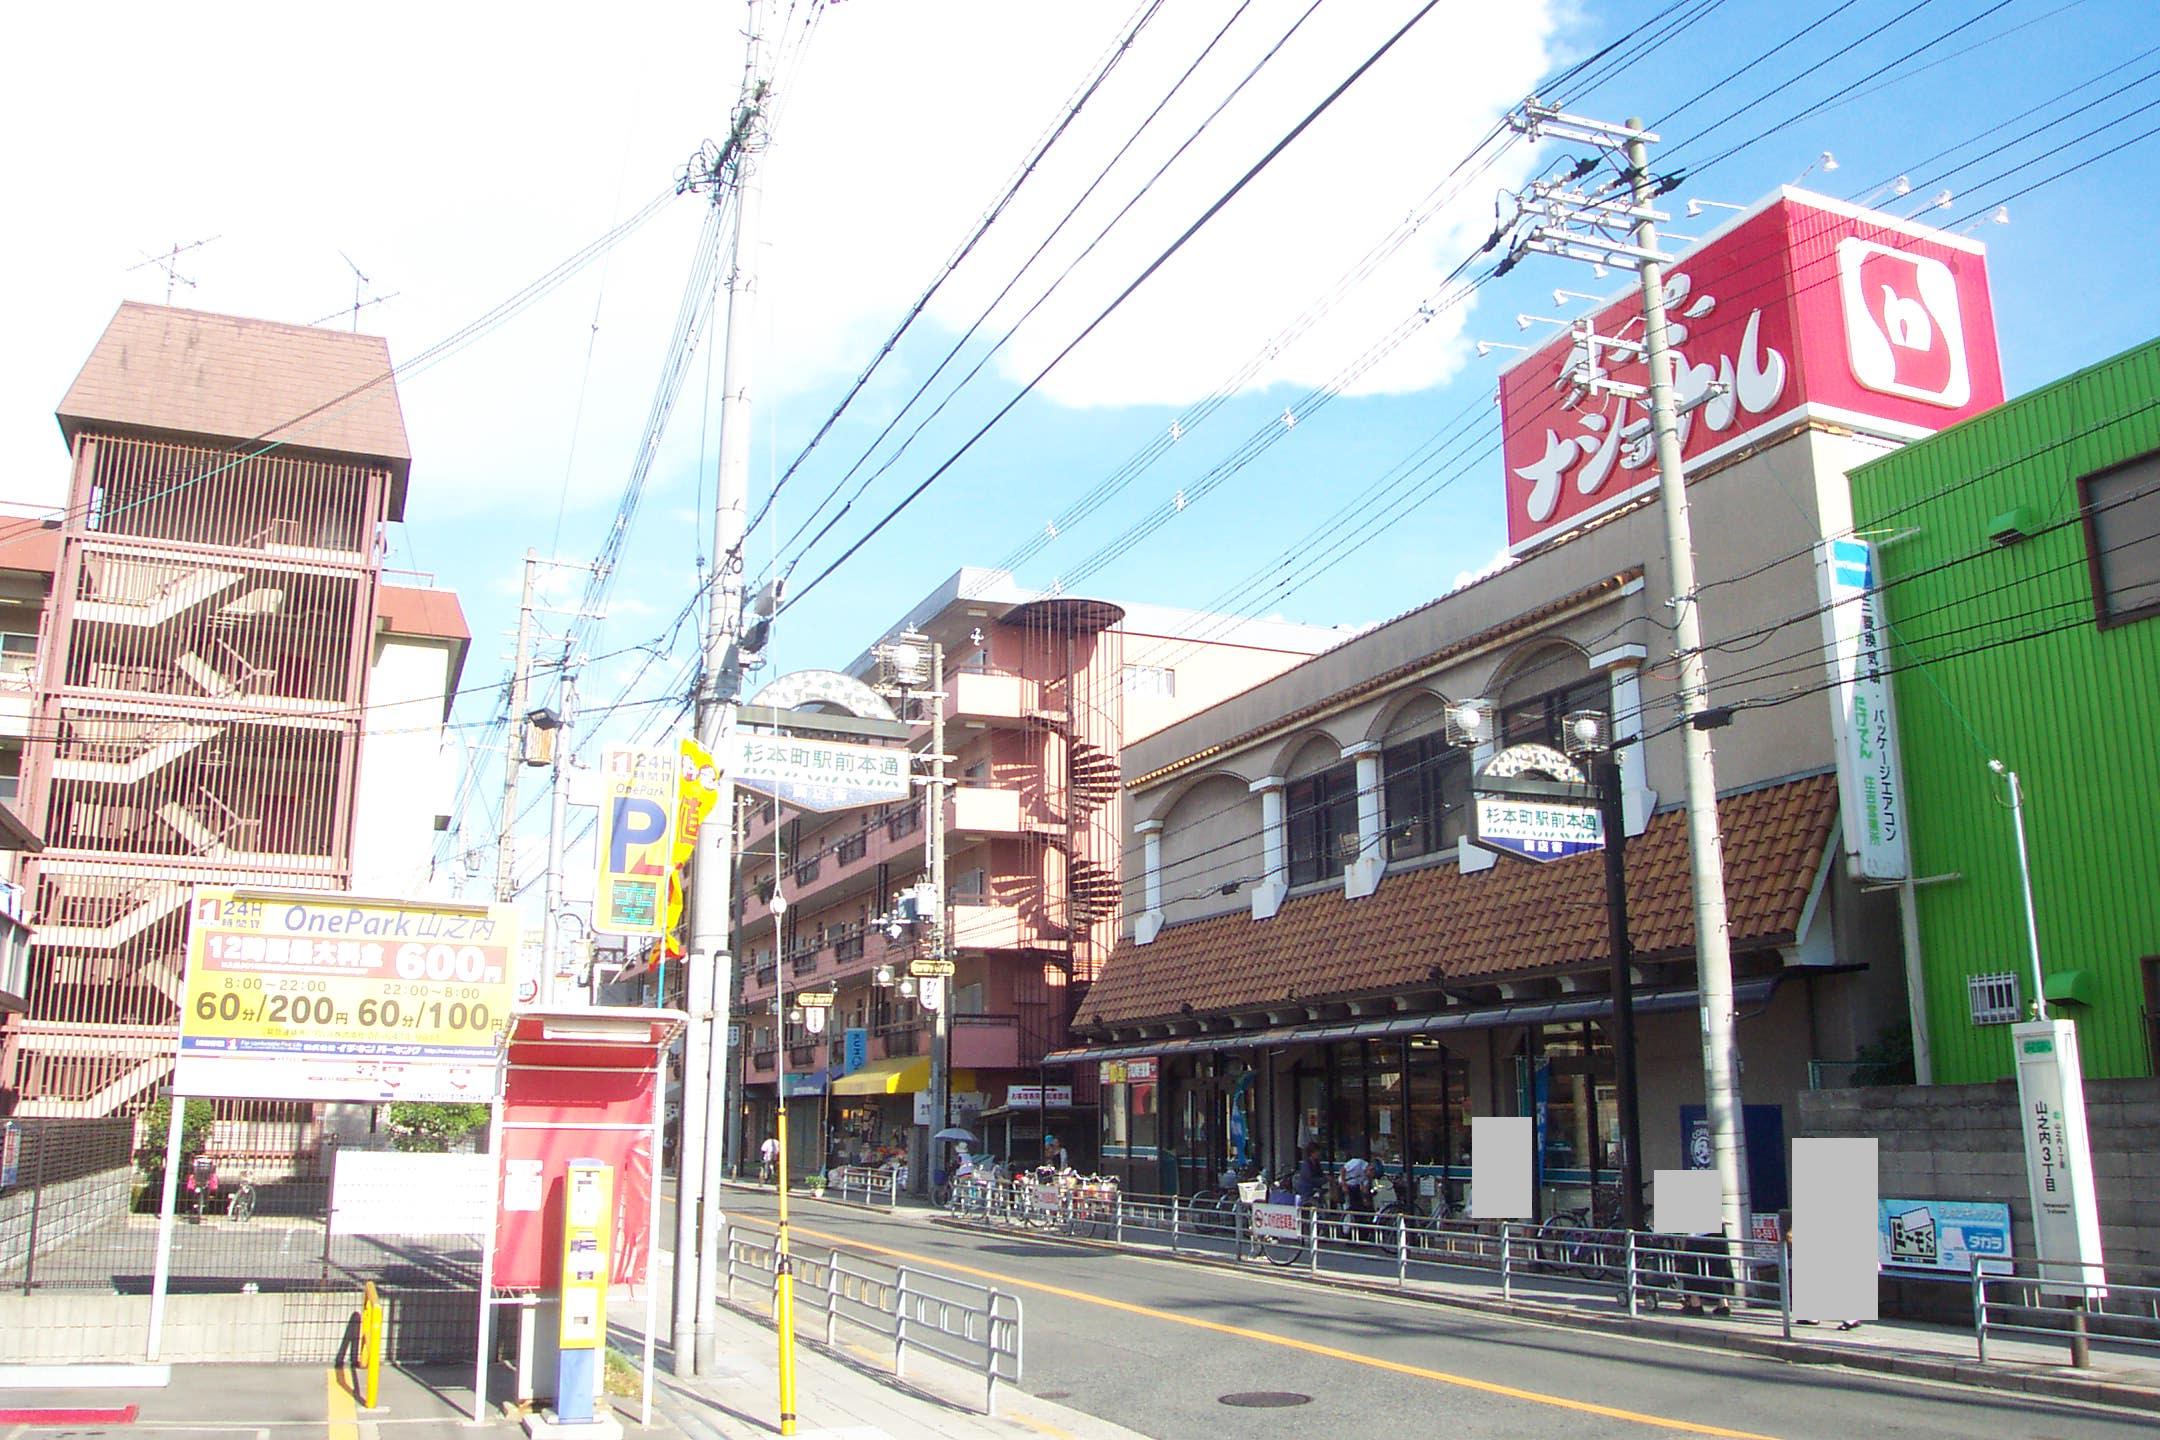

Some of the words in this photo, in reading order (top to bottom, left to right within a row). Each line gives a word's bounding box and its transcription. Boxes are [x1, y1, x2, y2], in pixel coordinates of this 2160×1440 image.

[634, 752, 672, 769] 24H
[743, 740, 899, 776] 杉本町駅前本通
[609, 797, 667, 873] P
[1485, 806, 1597, 831] 杉本町駅前本通
[223, 901, 263, 917] 24H
[284, 904, 411, 936] OnePark
[416, 911, 496, 941] 山之内
[196, 992, 349, 1025] 60分/200円
[358, 998, 504, 1031] 60分/100円
[2035, 1101, 2056, 1192] 山之内3丁目
[1968, 1235, 2003, 1250] タカラ
